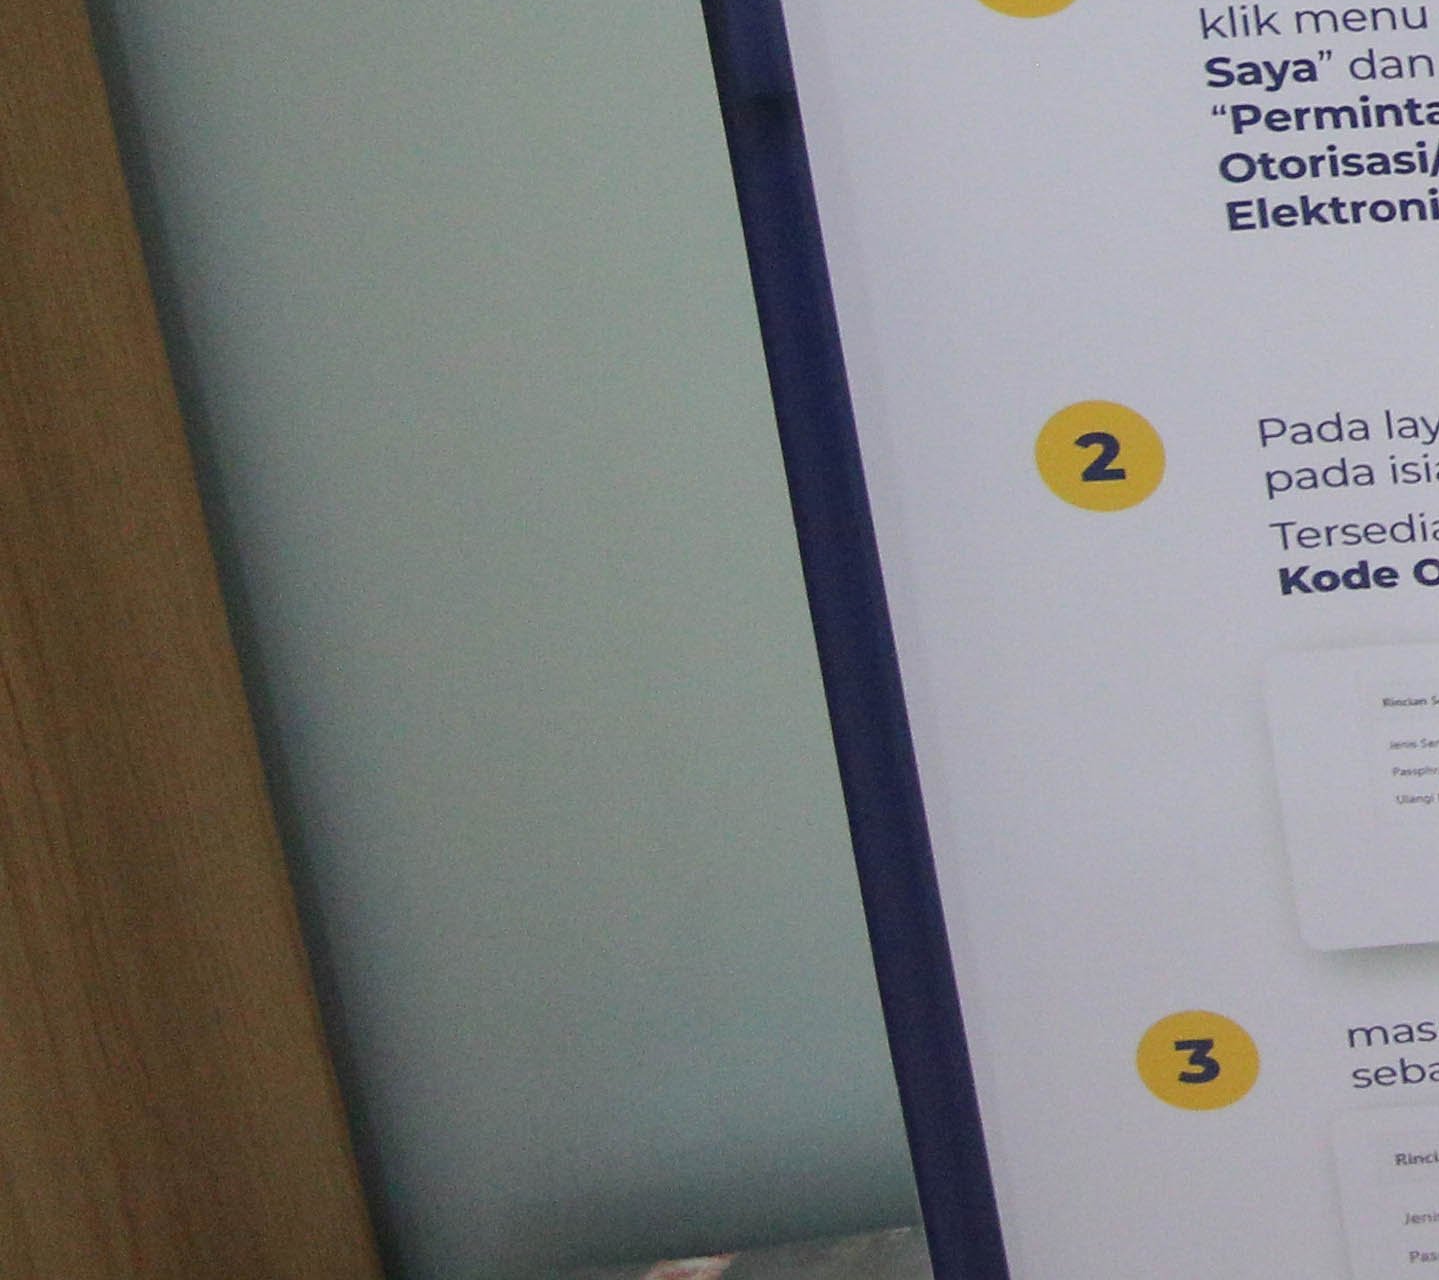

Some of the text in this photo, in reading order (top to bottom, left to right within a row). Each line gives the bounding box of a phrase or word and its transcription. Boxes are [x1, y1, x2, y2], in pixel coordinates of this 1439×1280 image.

[1199, 4, 1280, 40] klik
[1294, 2, 1428, 34] menu
[1348, 44, 1434, 82] dan
[1259, 412, 1370, 448] Pada
[1074, 431, 1125, 482] 2
[1266, 459, 1374, 499] pada
[1278, 559, 1399, 596] Kode
[1174, 1037, 1220, 1084] 3
